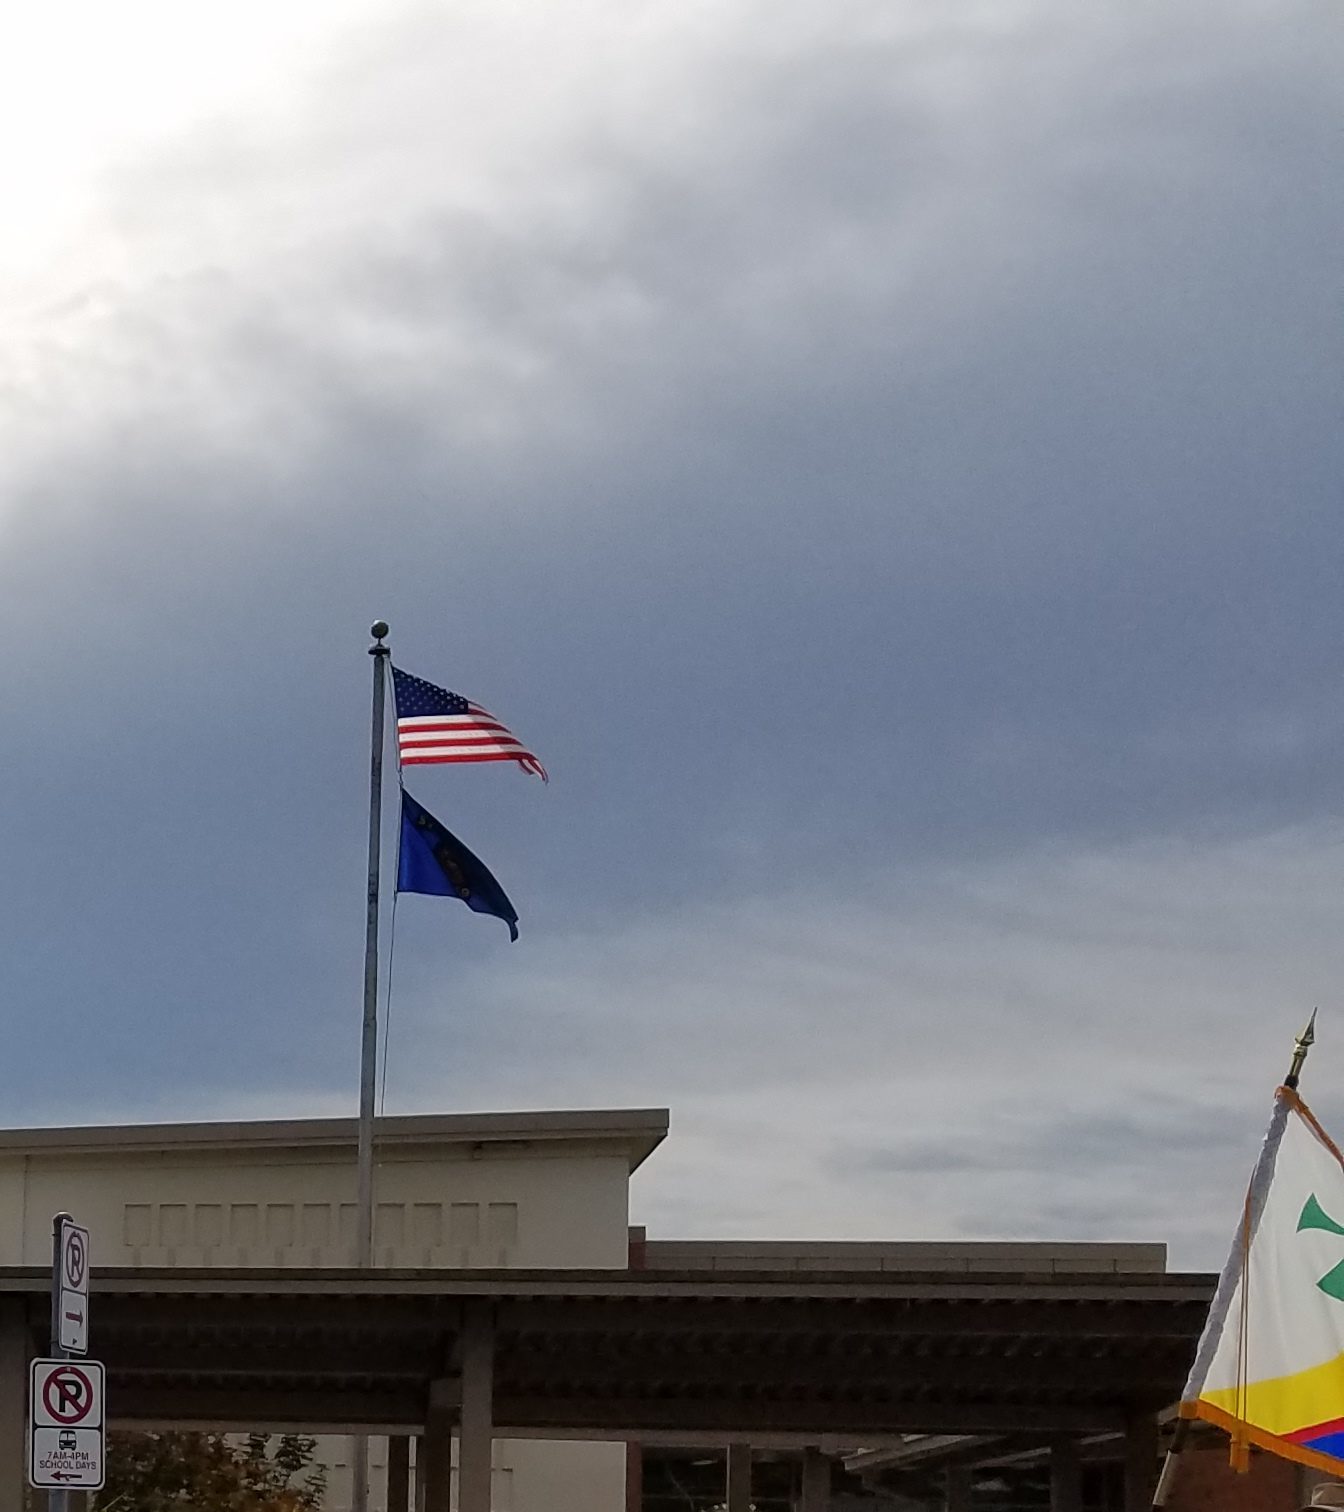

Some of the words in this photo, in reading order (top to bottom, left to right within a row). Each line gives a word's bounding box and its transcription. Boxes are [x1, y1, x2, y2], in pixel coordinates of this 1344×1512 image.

[47, 1451, 89, 1461] 7AM-4PM
[39, 1460, 74, 1469] SCHOOL
[75, 1461, 97, 1470] DAYS
